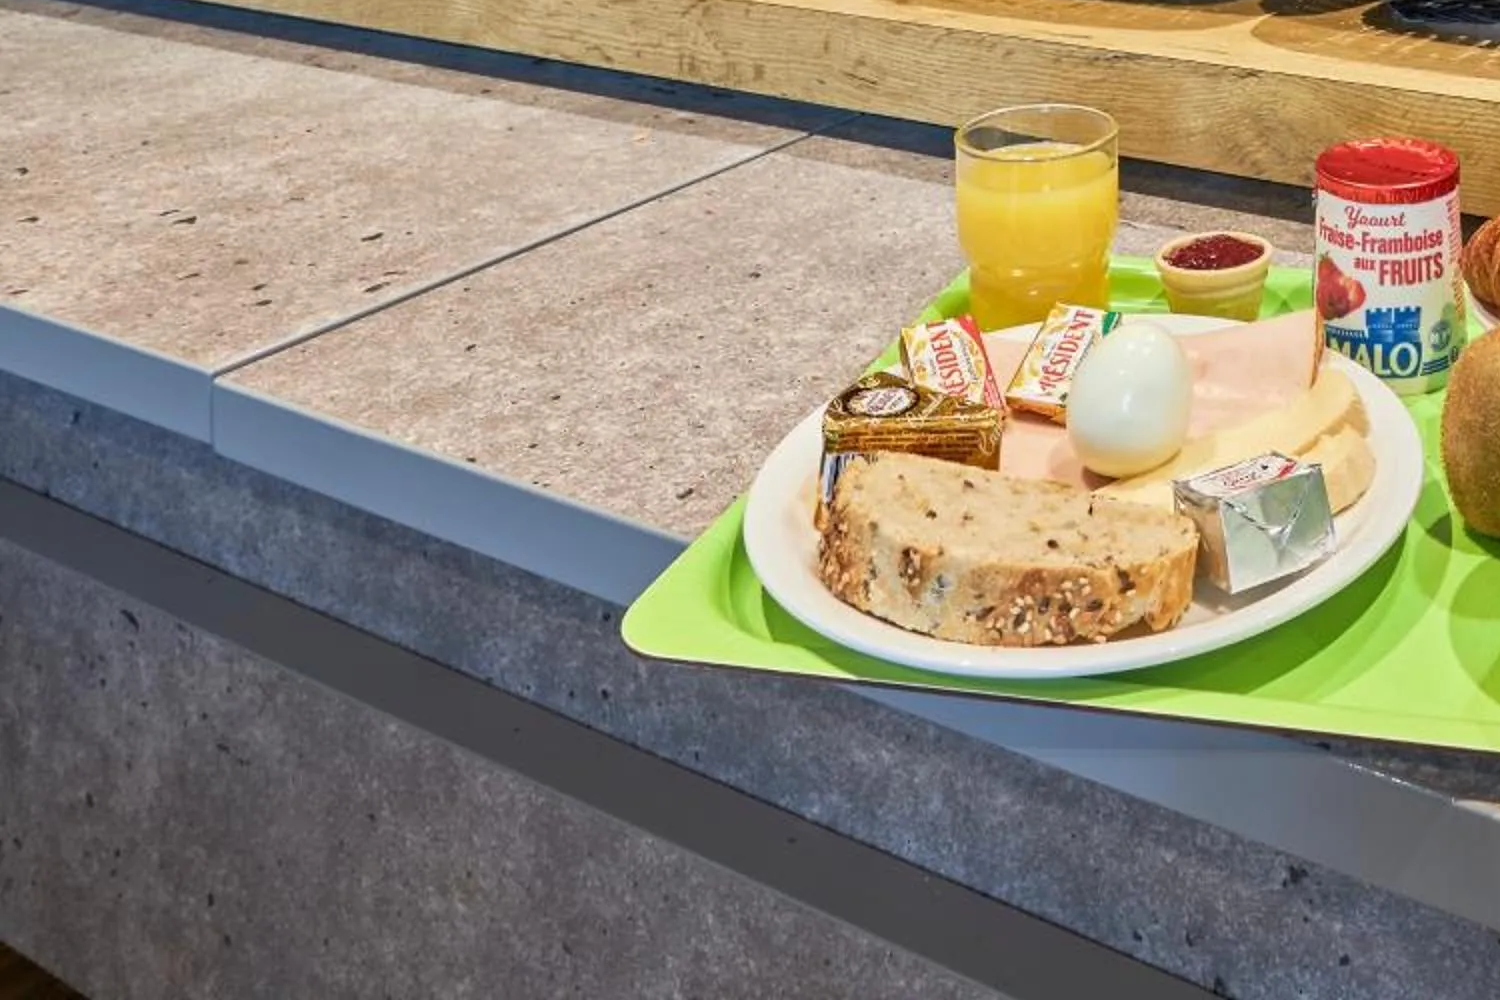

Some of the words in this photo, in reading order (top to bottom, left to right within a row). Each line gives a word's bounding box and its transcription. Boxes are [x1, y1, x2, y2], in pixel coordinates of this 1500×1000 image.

[1343, 205, 1408, 229] Yaourt
[1353, 256, 1376, 271] aux
[1379, 252, 1445, 287] FRUITS
